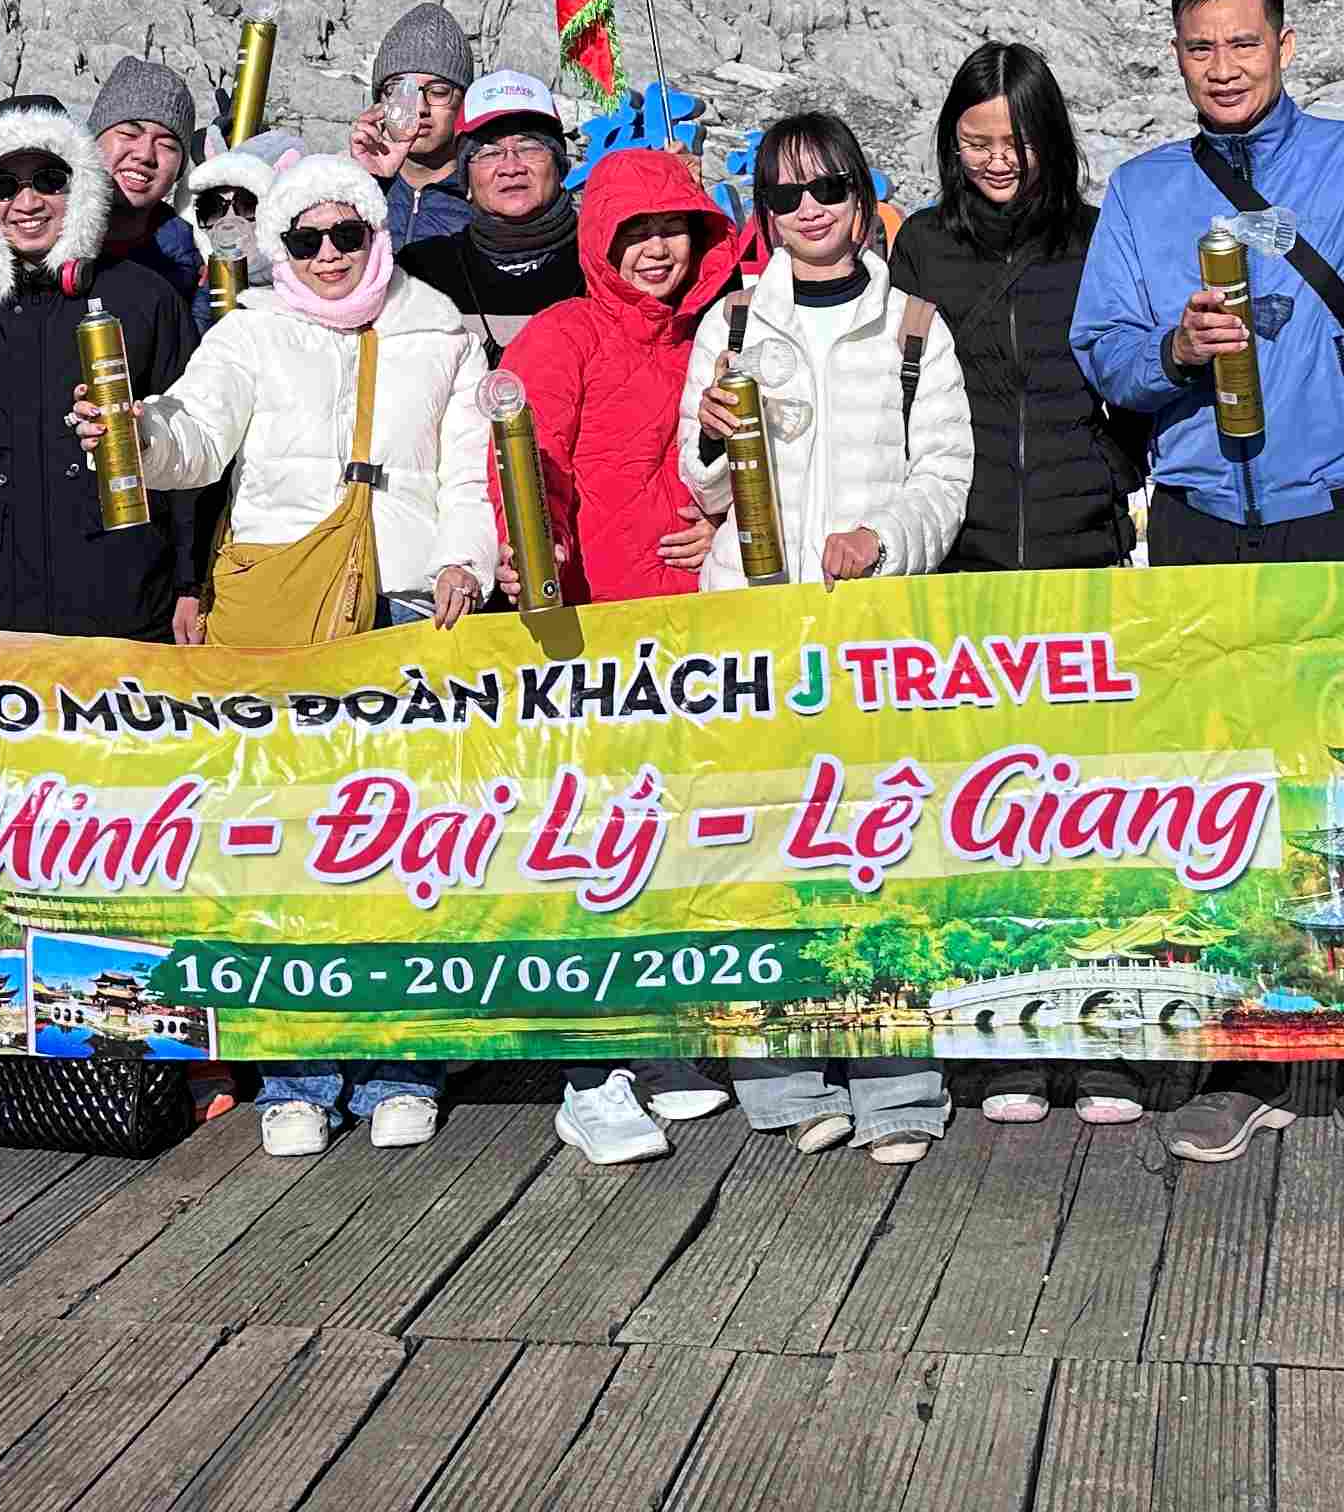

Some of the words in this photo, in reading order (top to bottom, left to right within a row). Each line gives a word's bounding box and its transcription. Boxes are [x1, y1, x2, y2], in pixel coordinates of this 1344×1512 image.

[62, 674, 273, 733] MÙNG
[287, 667, 500, 727] ĐOÀN
[521, 642, 770, 721] KHÁCH
[791, 661, 823, 708] J
[844, 640, 1134, 705] TRAVEL
[311, 777, 510, 900] Đại
[526, 771, 659, 904] Lý
[785, 759, 921, 884] Lệ
[948, 753, 1266, 883] Giang
[175, 954, 354, 1003] 16/06
[403, 943, 785, 1005] 20/06/2026
